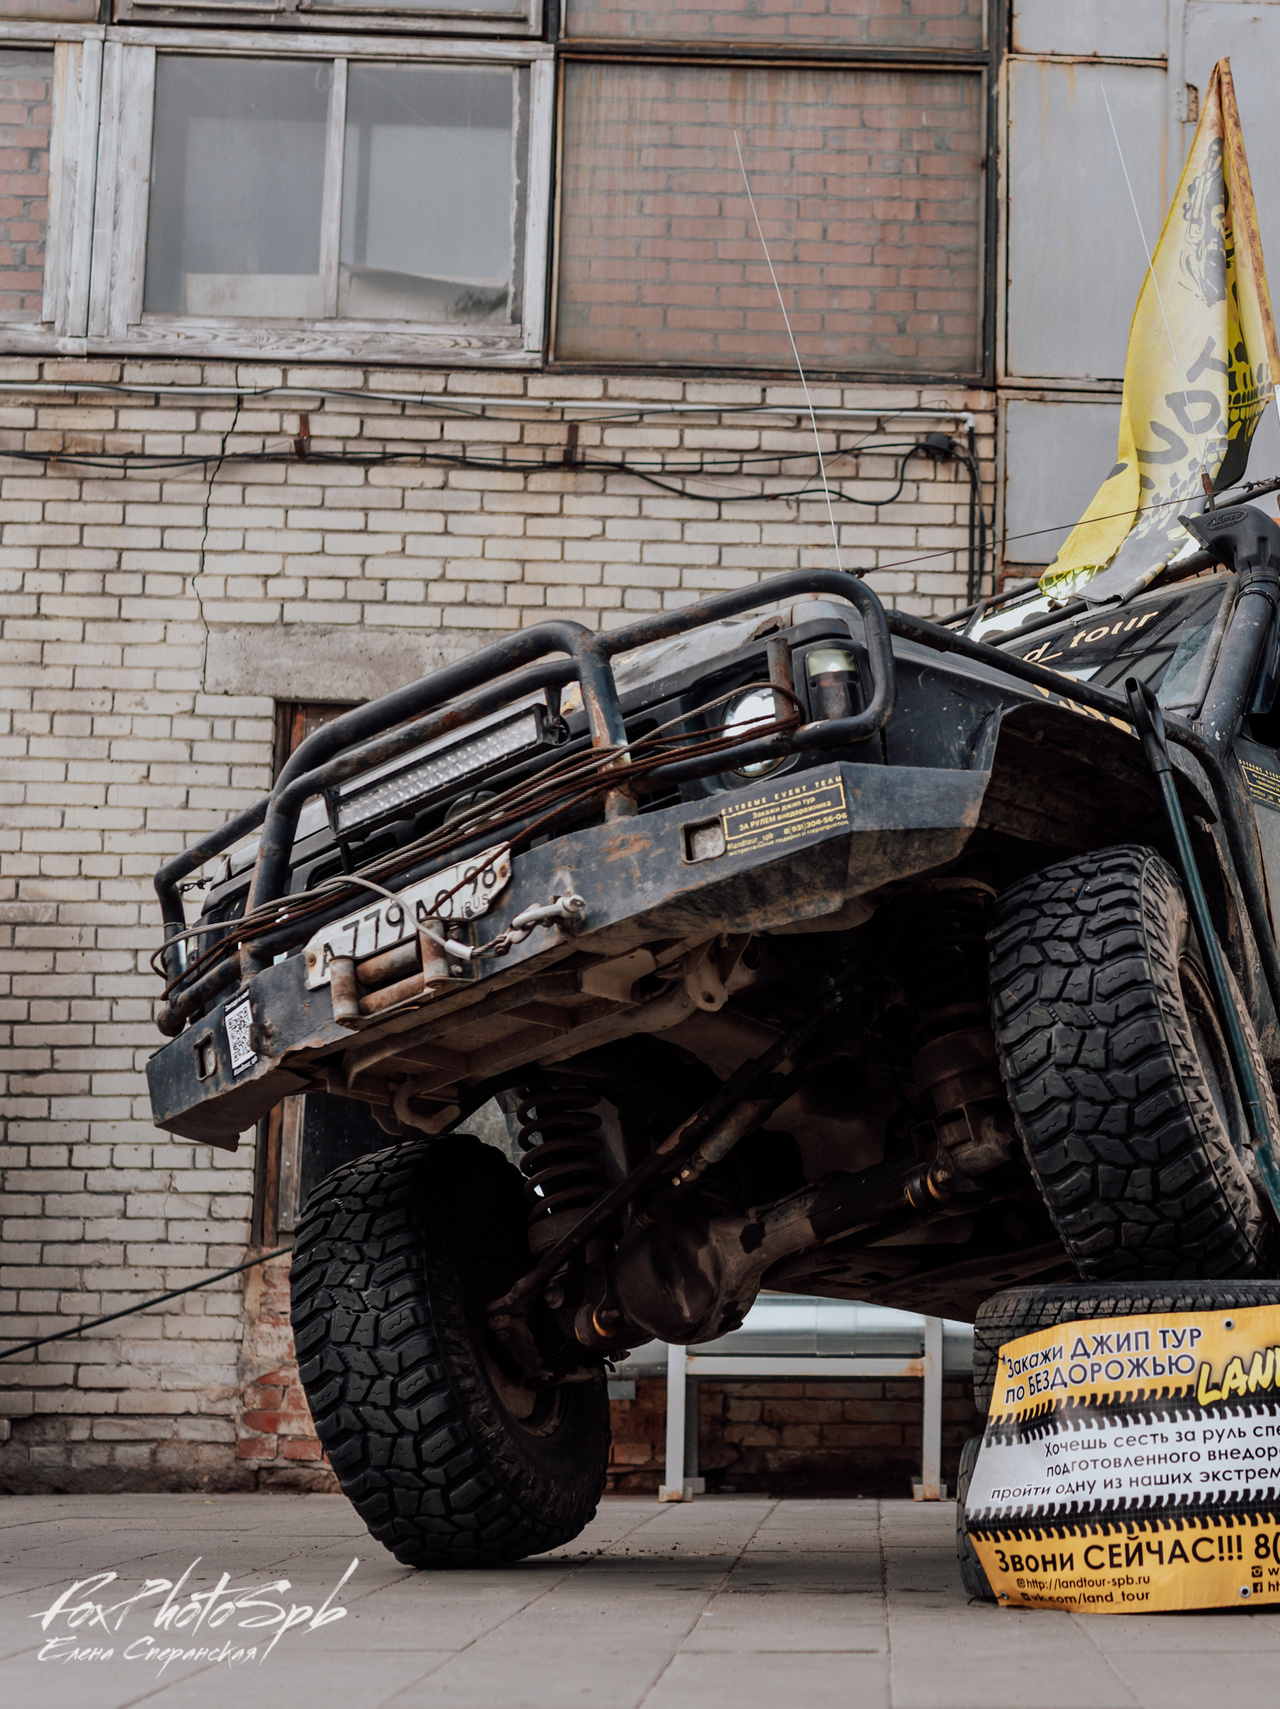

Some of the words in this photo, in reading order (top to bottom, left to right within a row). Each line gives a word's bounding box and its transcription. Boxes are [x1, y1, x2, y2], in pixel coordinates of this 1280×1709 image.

[721, 797, 767, 815] EXTREME
[774, 785, 807, 800] EVENT
[814, 775, 842, 788] TEAM
[750, 816, 777, 829] РУЛЕМ
[752, 806, 780, 819] Закажи
[1006, 1344, 1064, 1379] Закажи
[1070, 1329, 1151, 1361] ДЖИП
[1158, 1326, 1203, 1351] ТУР
[1004, 1384, 1026, 1405] по
[1027, 1353, 1197, 1398] БЕЗДОРОЖЬЮ
[1044, 1437, 1108, 1459] Хочешь
[1113, 1432, 1169, 1448] сесть
[1175, 1430, 1196, 1443] за
[1203, 1428, 1247, 1444] руль
[1046, 1450, 1201, 1477] подготовленного
[991, 1483, 1051, 1502] пройти
[1055, 1479, 1097, 1495] одну
[1103, 1476, 1122, 1489] из
[1129, 1472, 1193, 1487] наших
[994, 1549, 1075, 1573] Звони
[1083, 1534, 1243, 1570] СЕЙЧАС!!!
[1027, 1575, 1150, 1591] http://landtour-spb.ru
